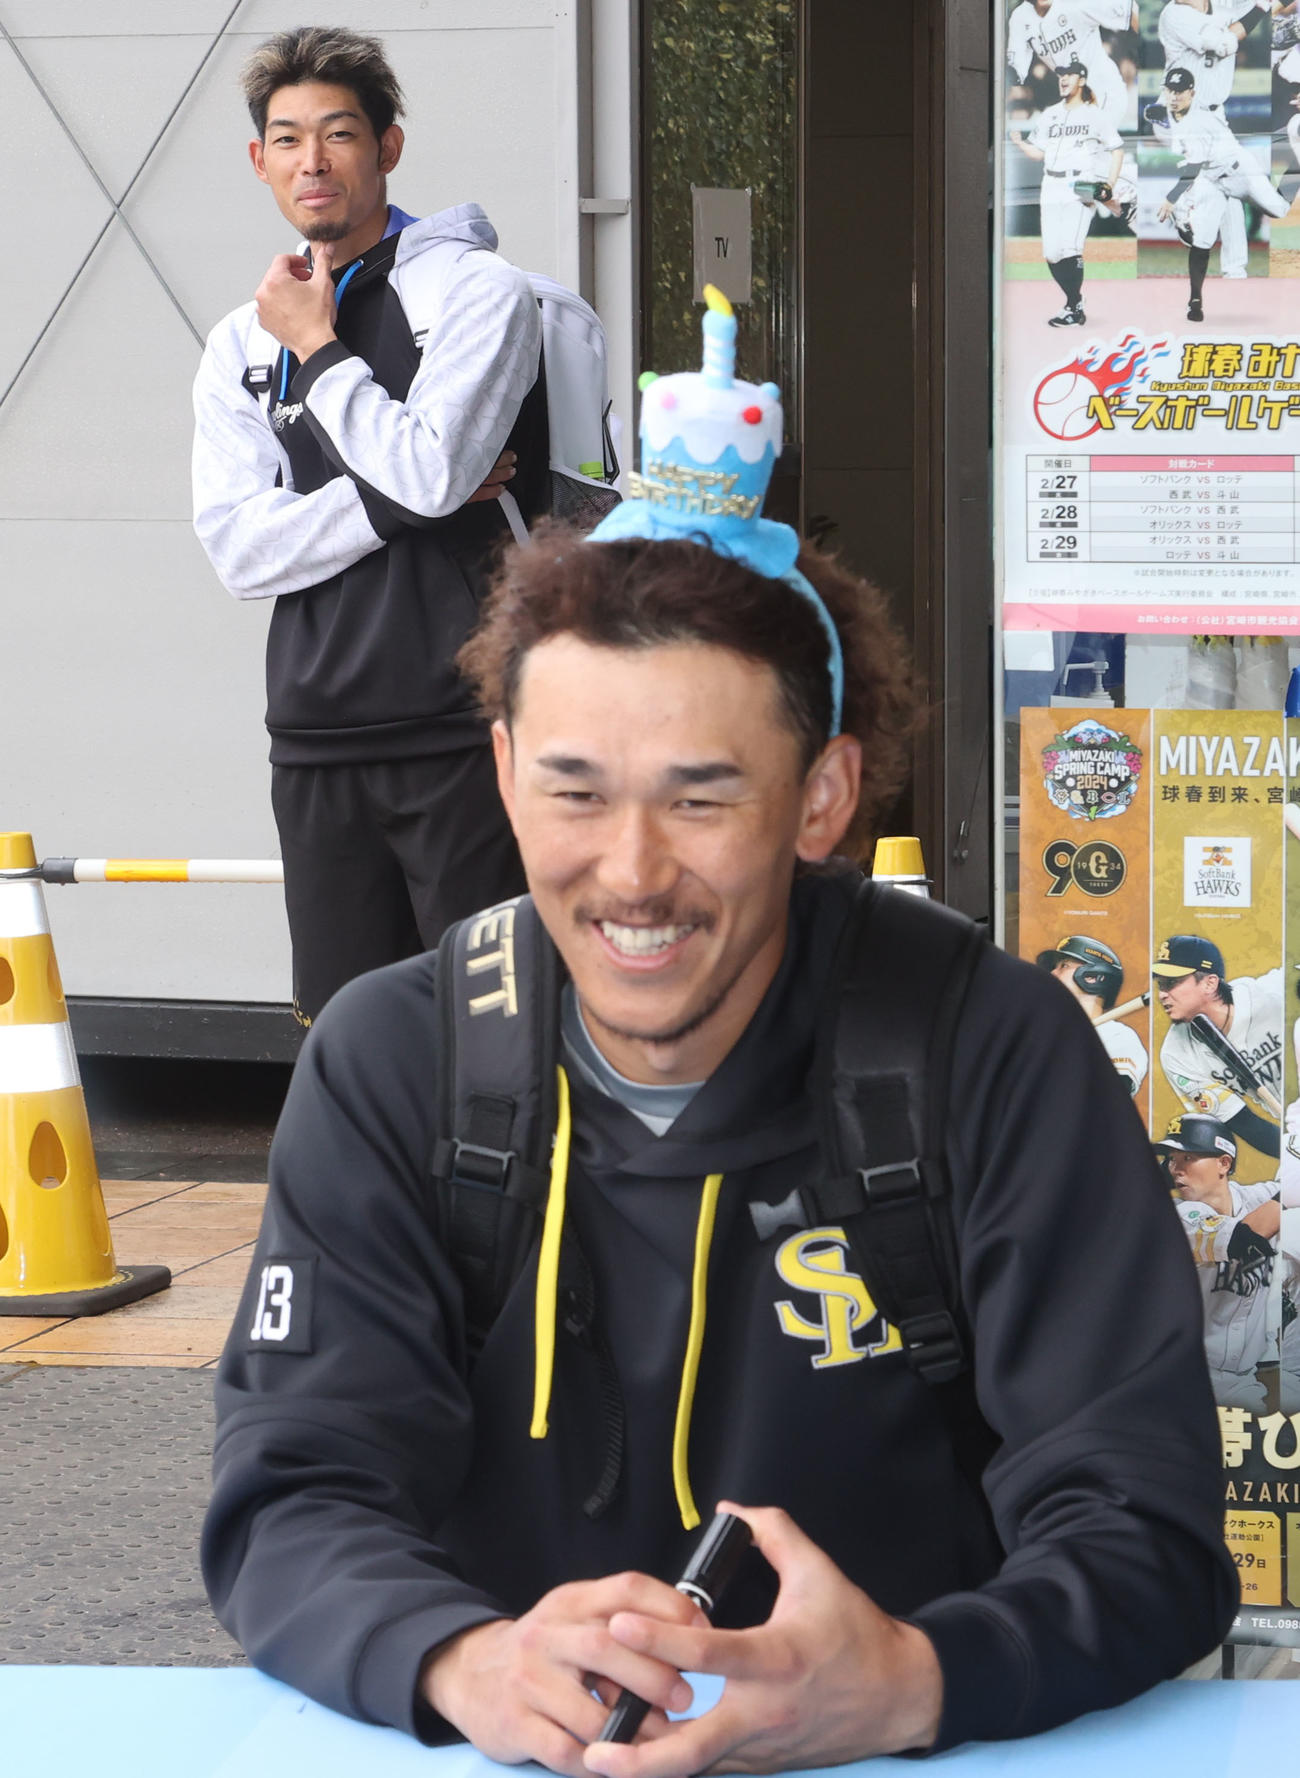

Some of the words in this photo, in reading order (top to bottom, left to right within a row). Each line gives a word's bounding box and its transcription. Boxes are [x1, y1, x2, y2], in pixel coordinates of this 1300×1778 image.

[714, 236, 729, 258] TV
[1179, 343, 1242, 379] 球春
[1273, 381, 1300, 392] Bas
[1041, 476, 1078, 489] 2/27
[1041, 505, 1078, 519] 2/28
[1041, 535, 1078, 549] 2/29
[1069, 750, 1115, 762] MIYAZAKI
[1054, 761, 1095, 780] SPRING
[1096, 761, 1130, 781] CAMP
[1076, 775, 1108, 790] 2024
[1198, 867, 1236, 880] SoftBank
[1193, 879, 1241, 897] HAWKS
[250, 1265, 294, 1341] 13
[1250, 1617, 1300, 1630] TEL.098
